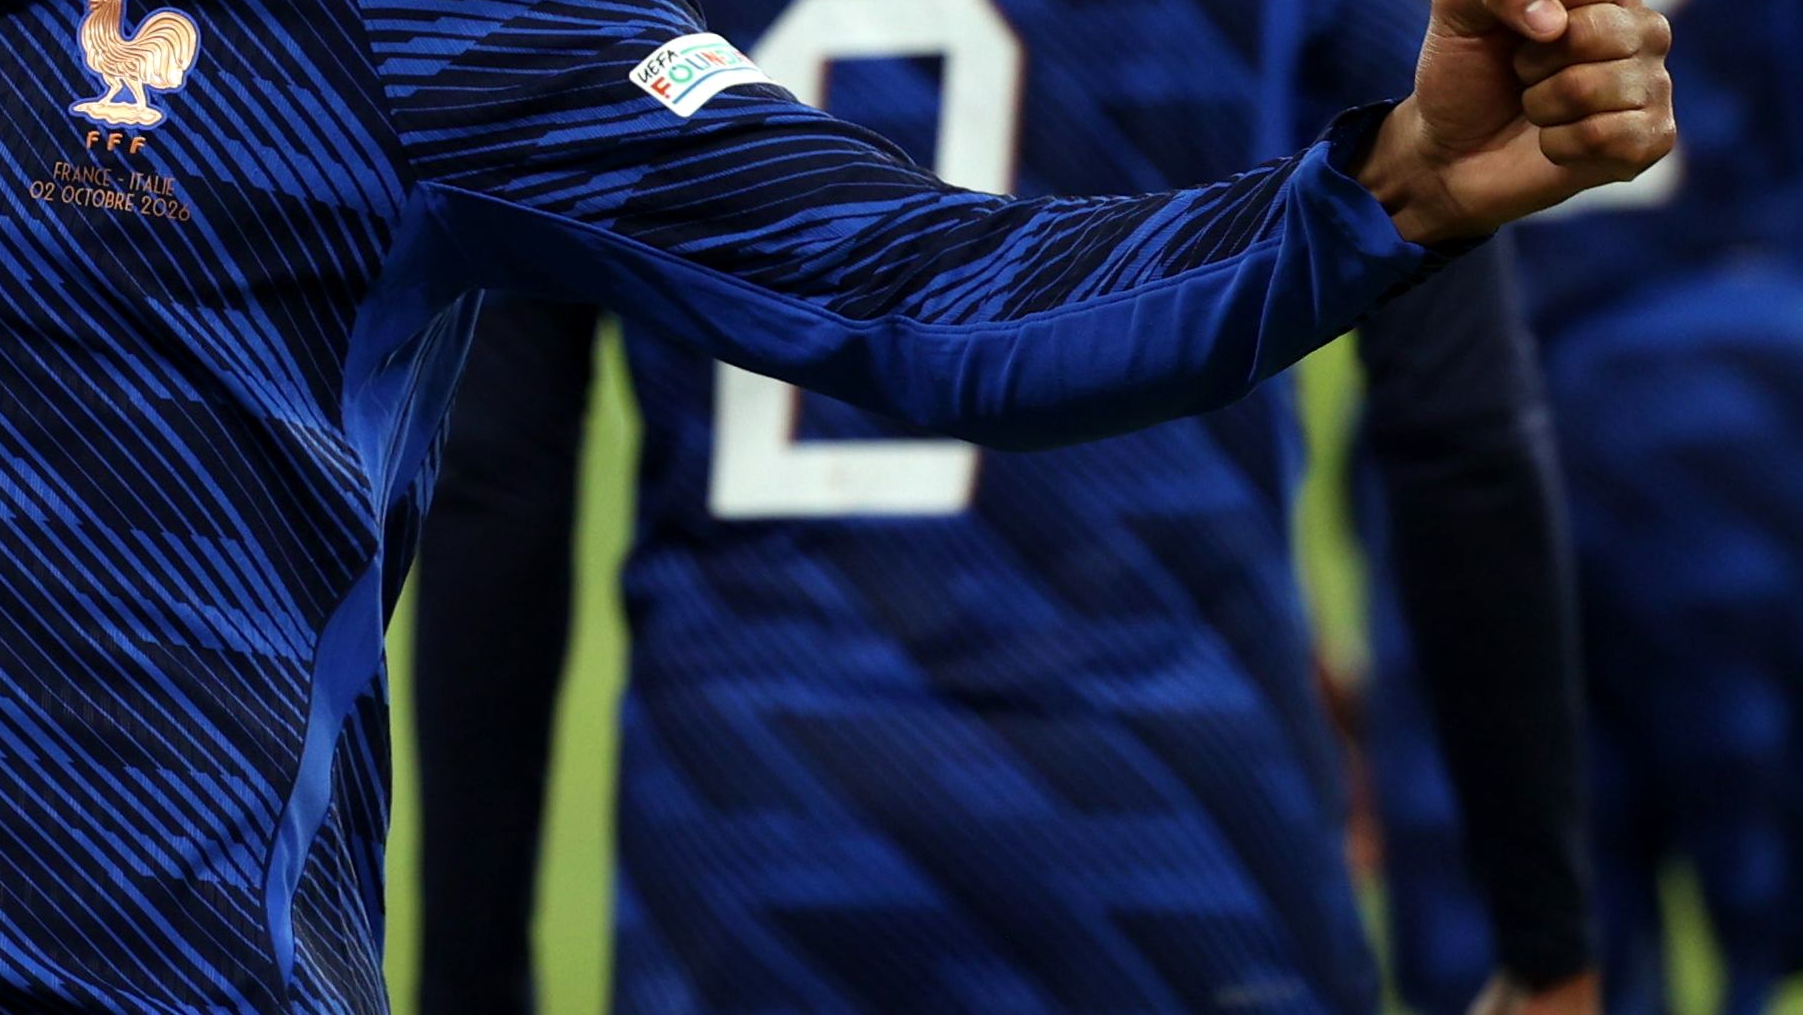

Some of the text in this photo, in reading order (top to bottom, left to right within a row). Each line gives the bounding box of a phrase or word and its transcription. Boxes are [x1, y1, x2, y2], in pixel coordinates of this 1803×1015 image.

[637, 49, 680, 84] UEFA
[53, 161, 112, 187] FRANCE
[129, 171, 176, 197] ITALIE
[29, 181, 191, 222] 02 OCTOBRE 2026
